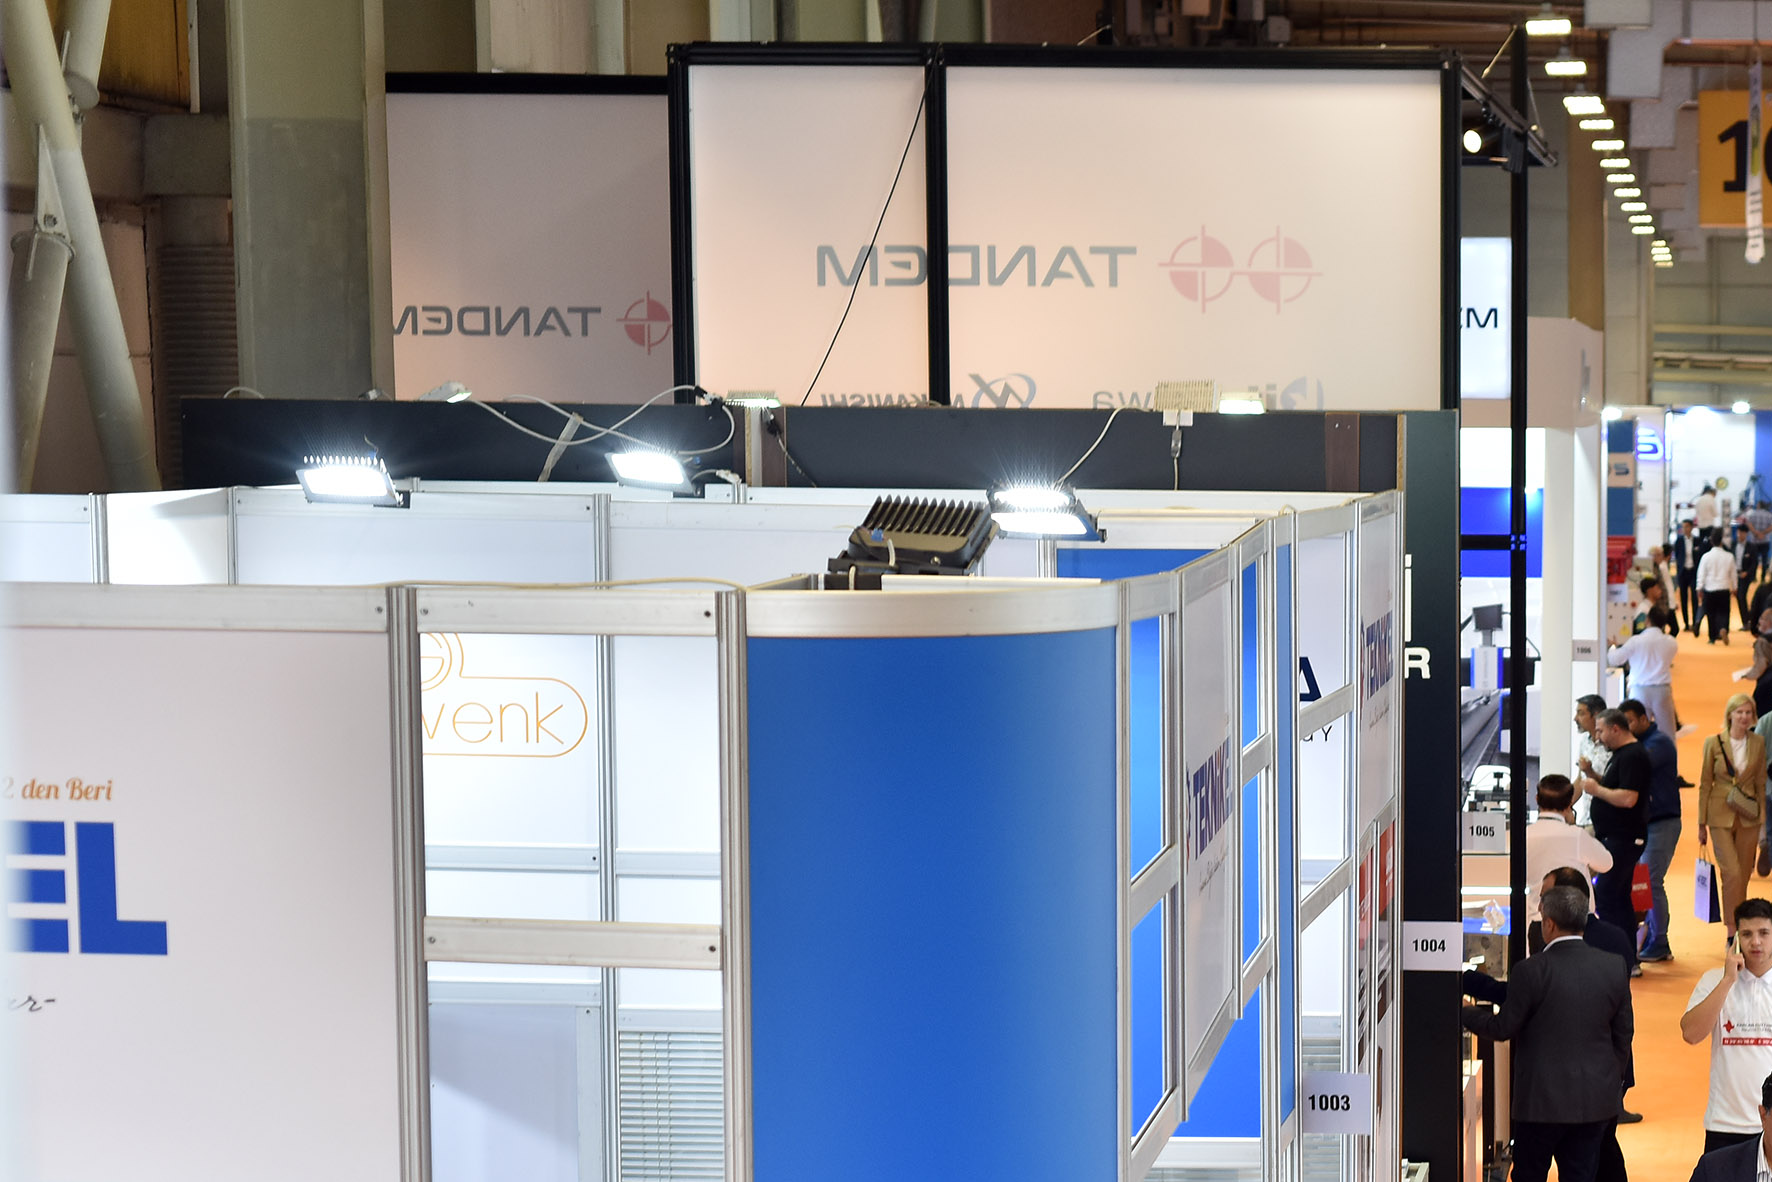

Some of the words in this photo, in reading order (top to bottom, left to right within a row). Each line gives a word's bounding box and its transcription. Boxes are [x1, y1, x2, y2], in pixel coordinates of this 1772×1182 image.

[1459, 308, 1498, 330] M
[21, 778, 60, 800] den
[66, 777, 114, 801] Beri
[1469, 824, 1495, 838] 1005
[1412, 939, 1447, 953] 1004
[1308, 1094, 1351, 1111] 1003
